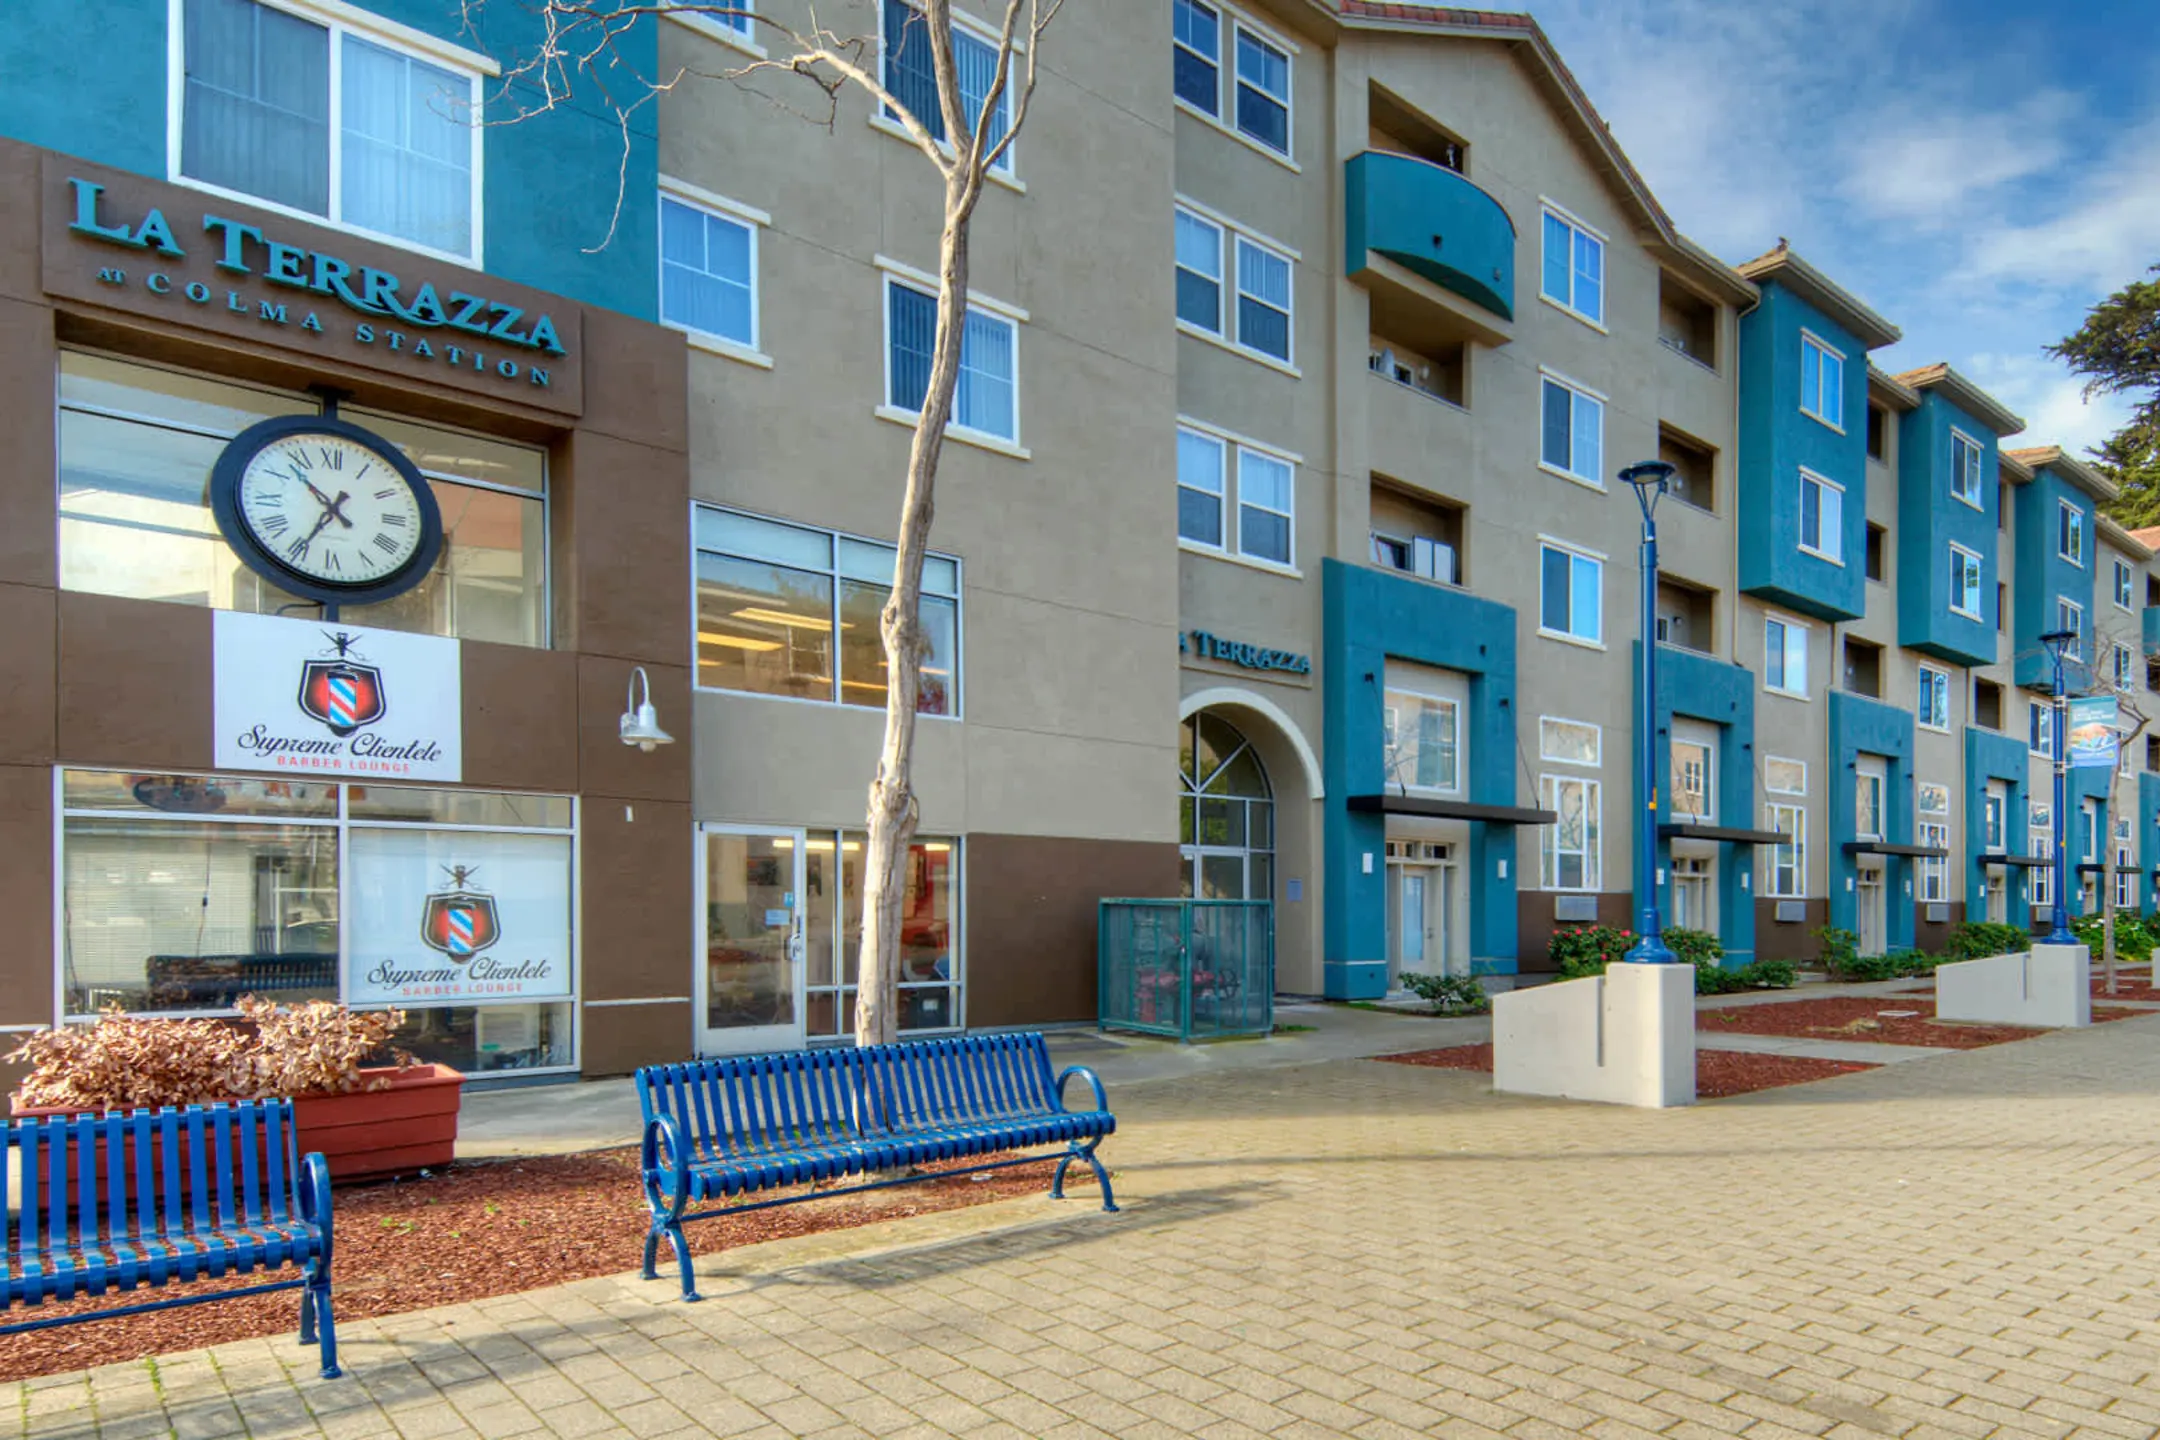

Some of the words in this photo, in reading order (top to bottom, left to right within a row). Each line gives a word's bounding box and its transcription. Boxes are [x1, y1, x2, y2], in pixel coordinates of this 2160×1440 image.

[67, 177, 187, 257] LA
[203, 213, 567, 356] TERRAZZA
[96, 266, 127, 285] AT
[146, 271, 324, 333] COLMA
[355, 322, 550, 387] STATION
[1192, 629, 1312, 675] TERRAZZA
[238, 723, 343, 758] Supreme
[350, 732, 442, 762] Clientele
[277, 754, 343, 769] BARBER
[350, 760, 411, 774] LOUNGE
[367, 959, 461, 991] Supreme
[468, 956, 552, 981] Clientele
[402, 984, 461, 997] BARBER
[468, 982, 523, 994] LOUNGE
